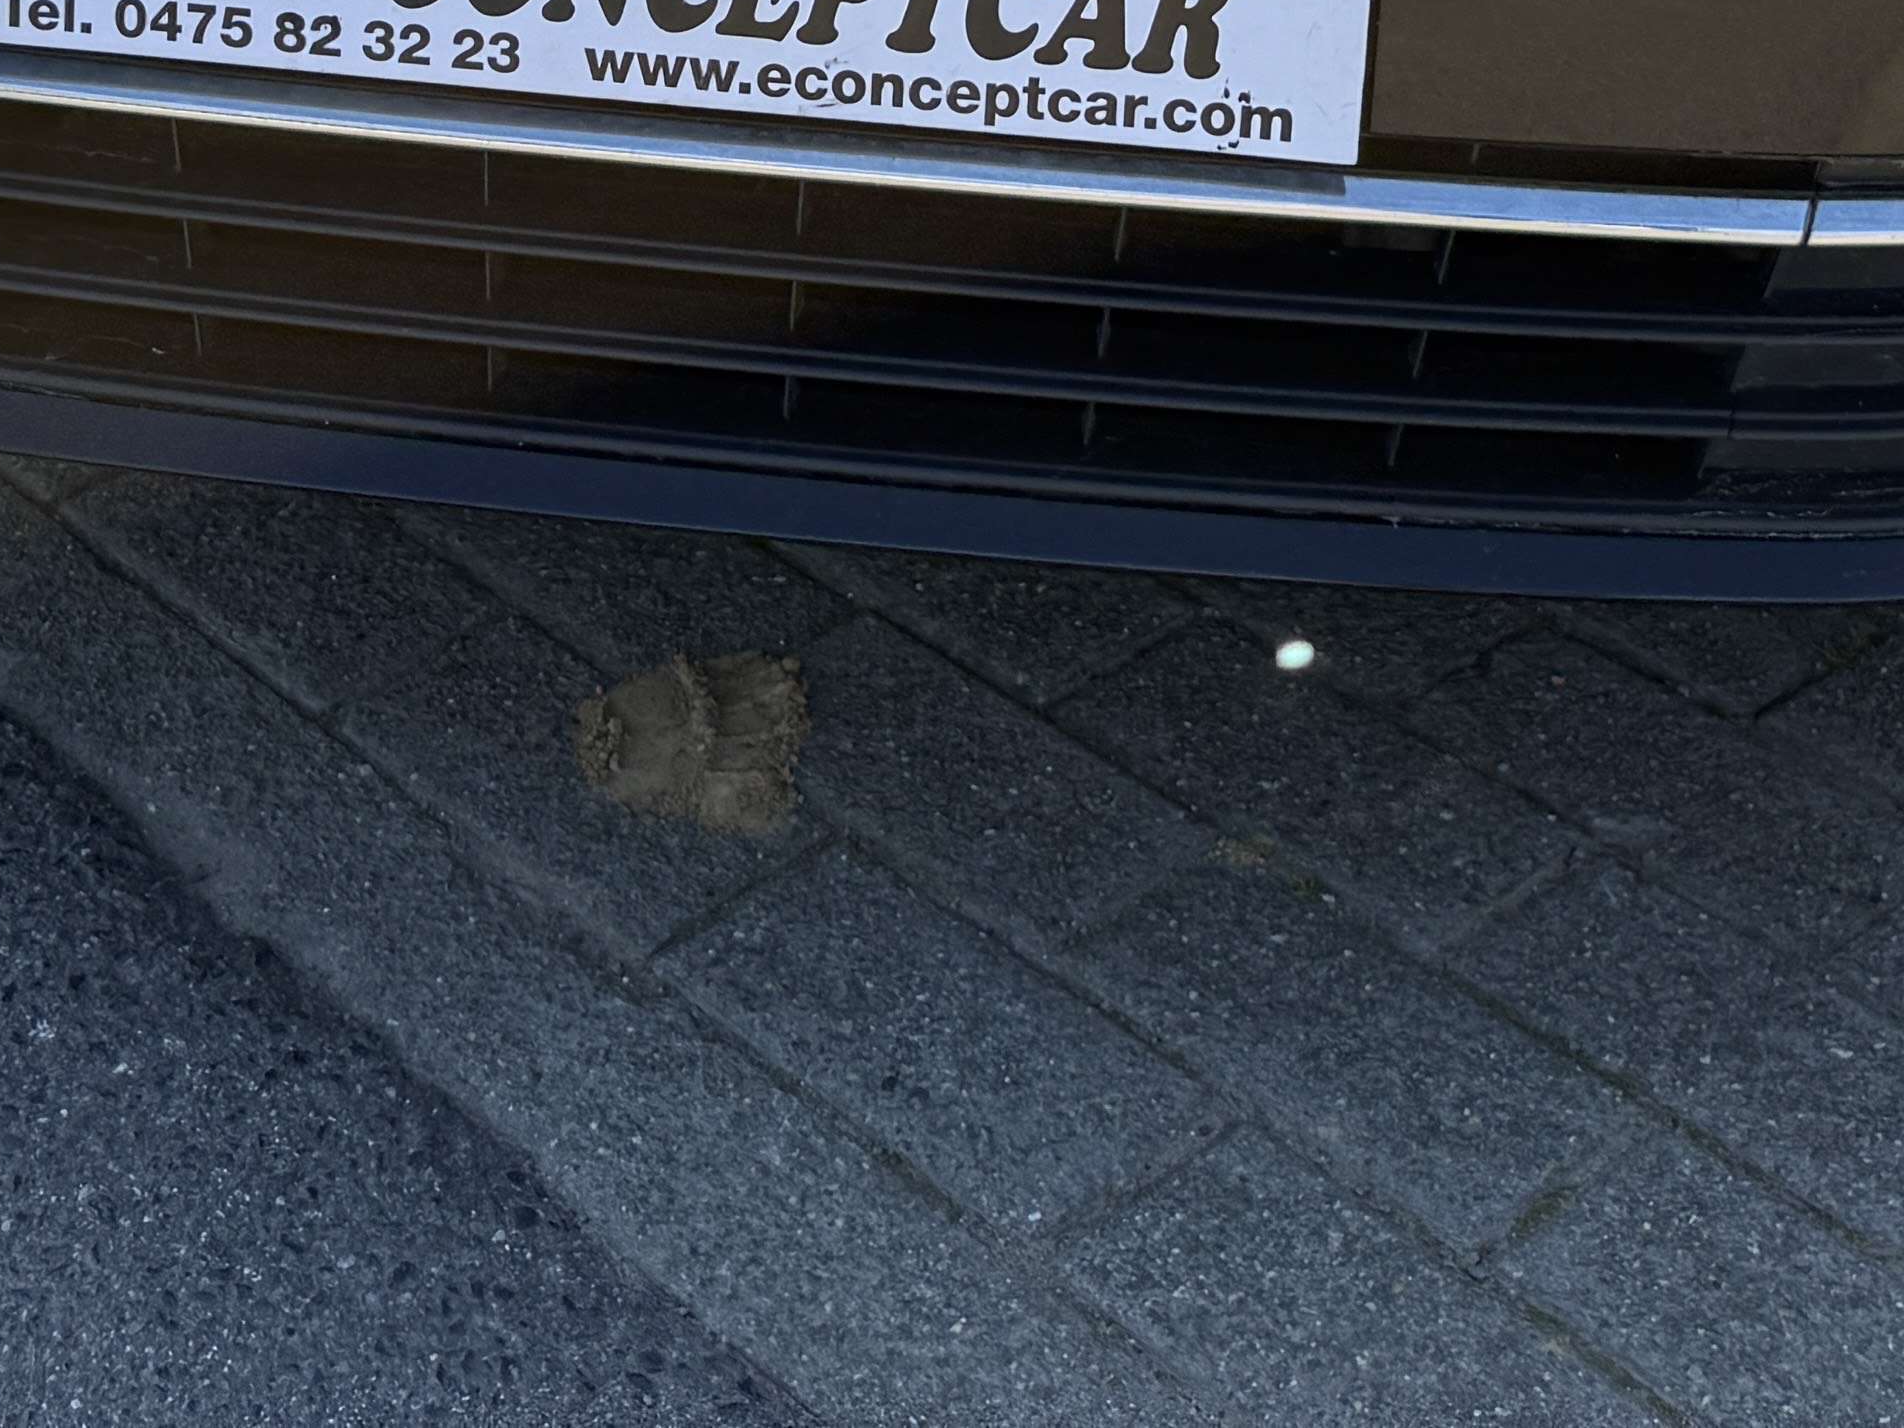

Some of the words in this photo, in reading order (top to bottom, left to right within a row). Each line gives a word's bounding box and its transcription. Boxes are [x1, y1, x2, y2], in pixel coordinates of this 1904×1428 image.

[273, 11, 343, 58] 82
[361, 20, 432, 67] 32
[451, 29, 521, 74] 23
[584, 46, 1295, 143] www.econceptcar.com
